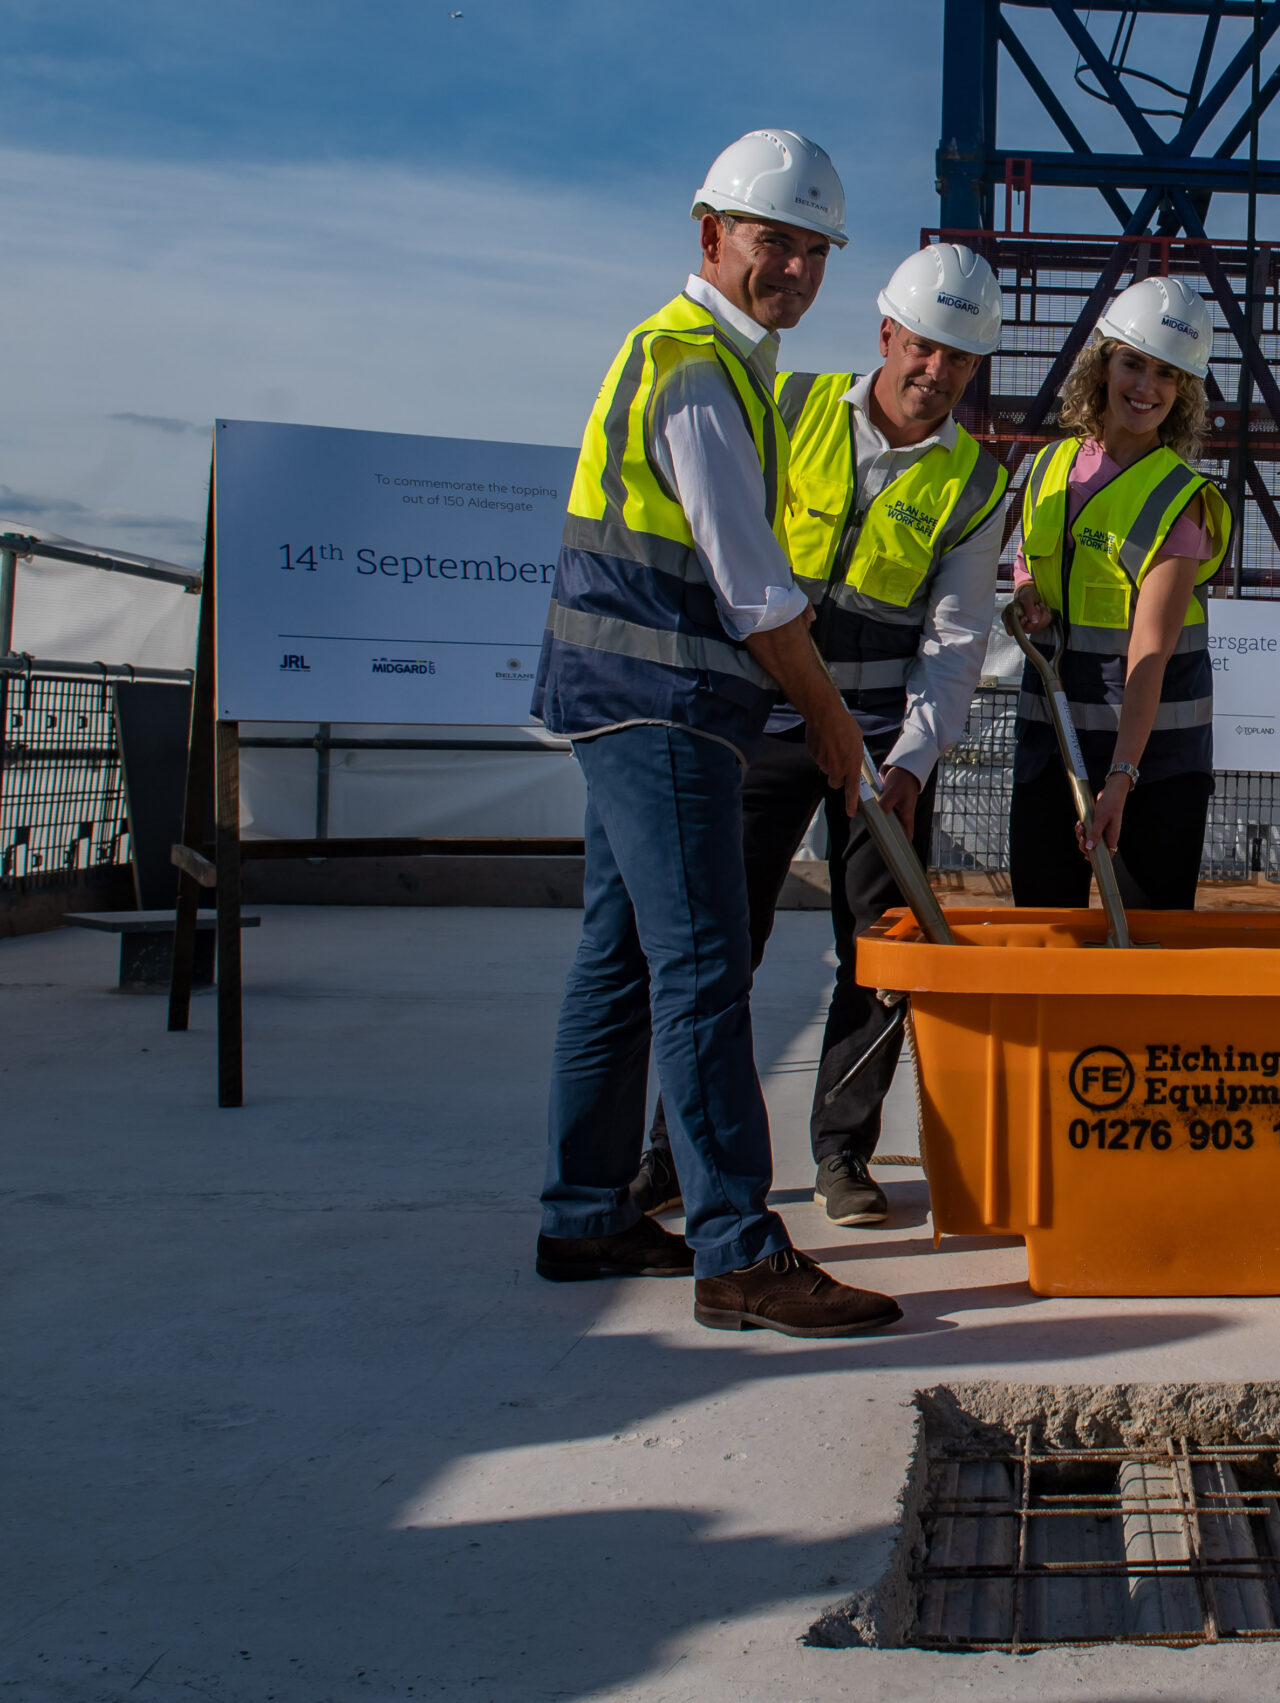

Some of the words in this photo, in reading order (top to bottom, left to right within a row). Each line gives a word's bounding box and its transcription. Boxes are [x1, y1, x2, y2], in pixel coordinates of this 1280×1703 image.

[936, 294, 980, 315] MIDGARD
[1161, 317, 1199, 339] MIDGARD
[375, 473, 391, 486] To
[393, 476, 485, 492] commemorate
[488, 482, 508, 494] the
[511, 485, 558, 499] topping
[402, 494, 424, 504] out
[427, 494, 440, 505] of
[443, 495, 465, 507] 150
[468, 497, 534, 513] Aldersgate
[895, 500, 919, 517] PLAN
[887, 510, 915, 527] WORK
[1083, 527, 1104, 541] PLAN
[1080, 537, 1103, 552] WORK
[279, 543, 345, 572] 14th
[356, 547, 556, 584] September
[1208, 635, 1278, 655] ersgate
[279, 654, 311, 669] JRL
[371, 662, 428, 675] MIDGARD
[1081, 1066, 1122, 1093] FE
[1068, 1118, 1172, 1150] 01276
[1188, 1118, 1254, 1150] 903
